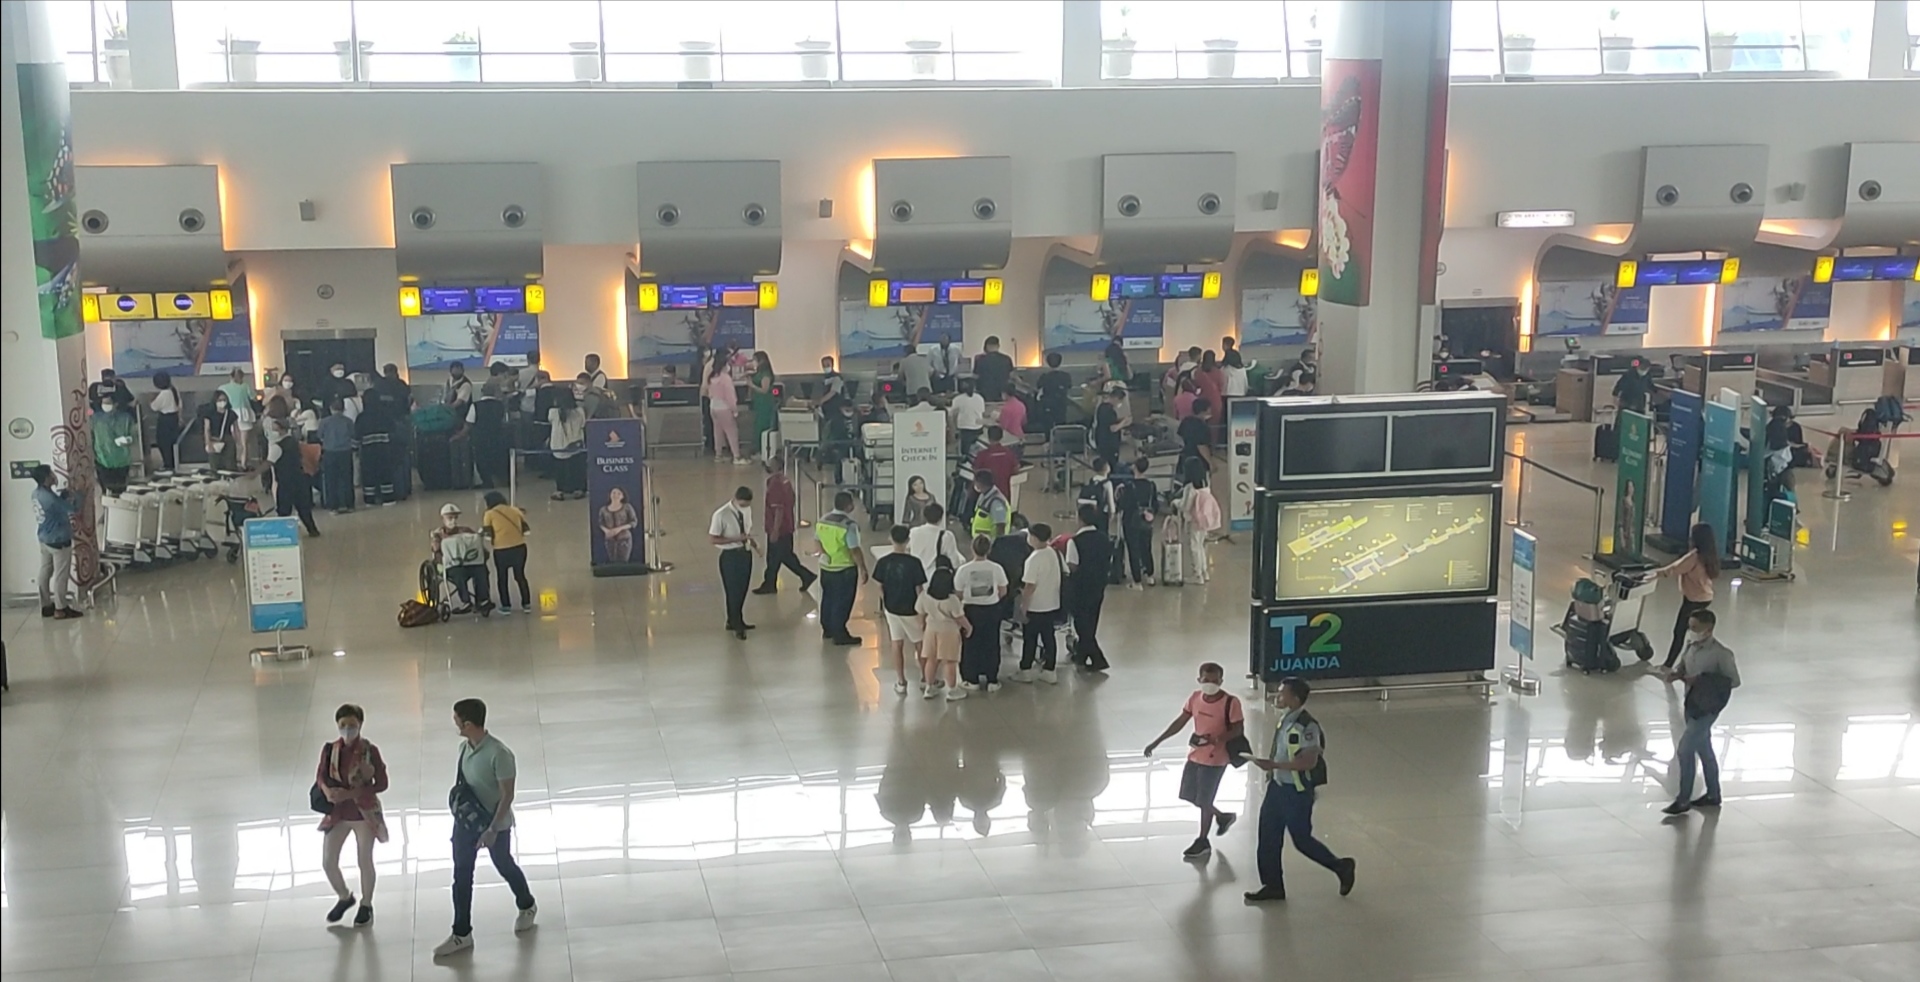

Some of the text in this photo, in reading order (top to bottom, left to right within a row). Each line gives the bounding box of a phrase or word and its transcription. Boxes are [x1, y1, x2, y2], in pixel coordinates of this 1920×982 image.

[1208, 275, 1218, 285] 18
[1305, 272, 1317, 281] 19
[989, 281, 1000, 291] 16
[1096, 277, 1107, 286] 17
[642, 287, 655, 296] 13
[763, 286, 774, 295] 14
[874, 283, 885, 292] 15
[529, 289, 542, 299] 12
[597, 457, 634, 465] BUSINESS
[1270, 612, 1343, 654] T2
[1269, 655, 1341, 672] JUANDA
